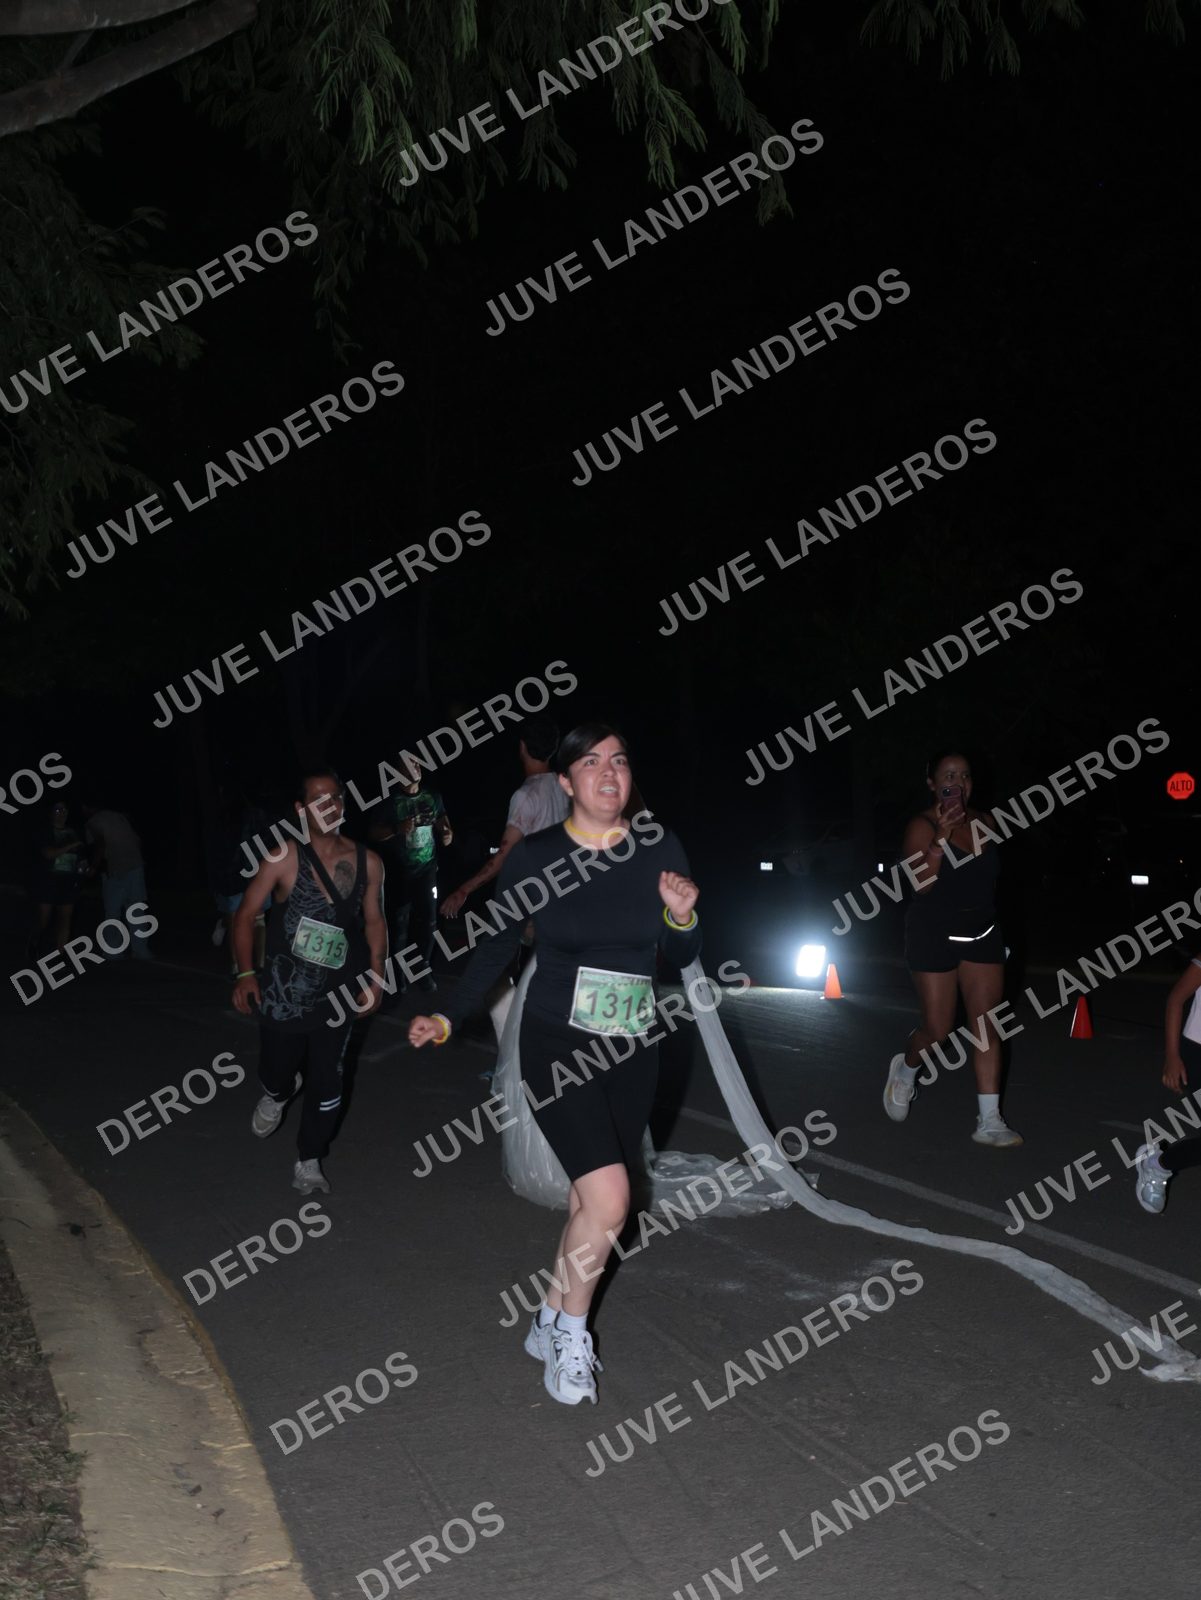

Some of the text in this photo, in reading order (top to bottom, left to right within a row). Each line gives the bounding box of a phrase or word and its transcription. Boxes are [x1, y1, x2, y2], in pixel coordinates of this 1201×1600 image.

[1169, 779, 1193, 792] ALTO
[303, 931, 344, 958] 1315
[586, 989, 648, 1022] 1316
